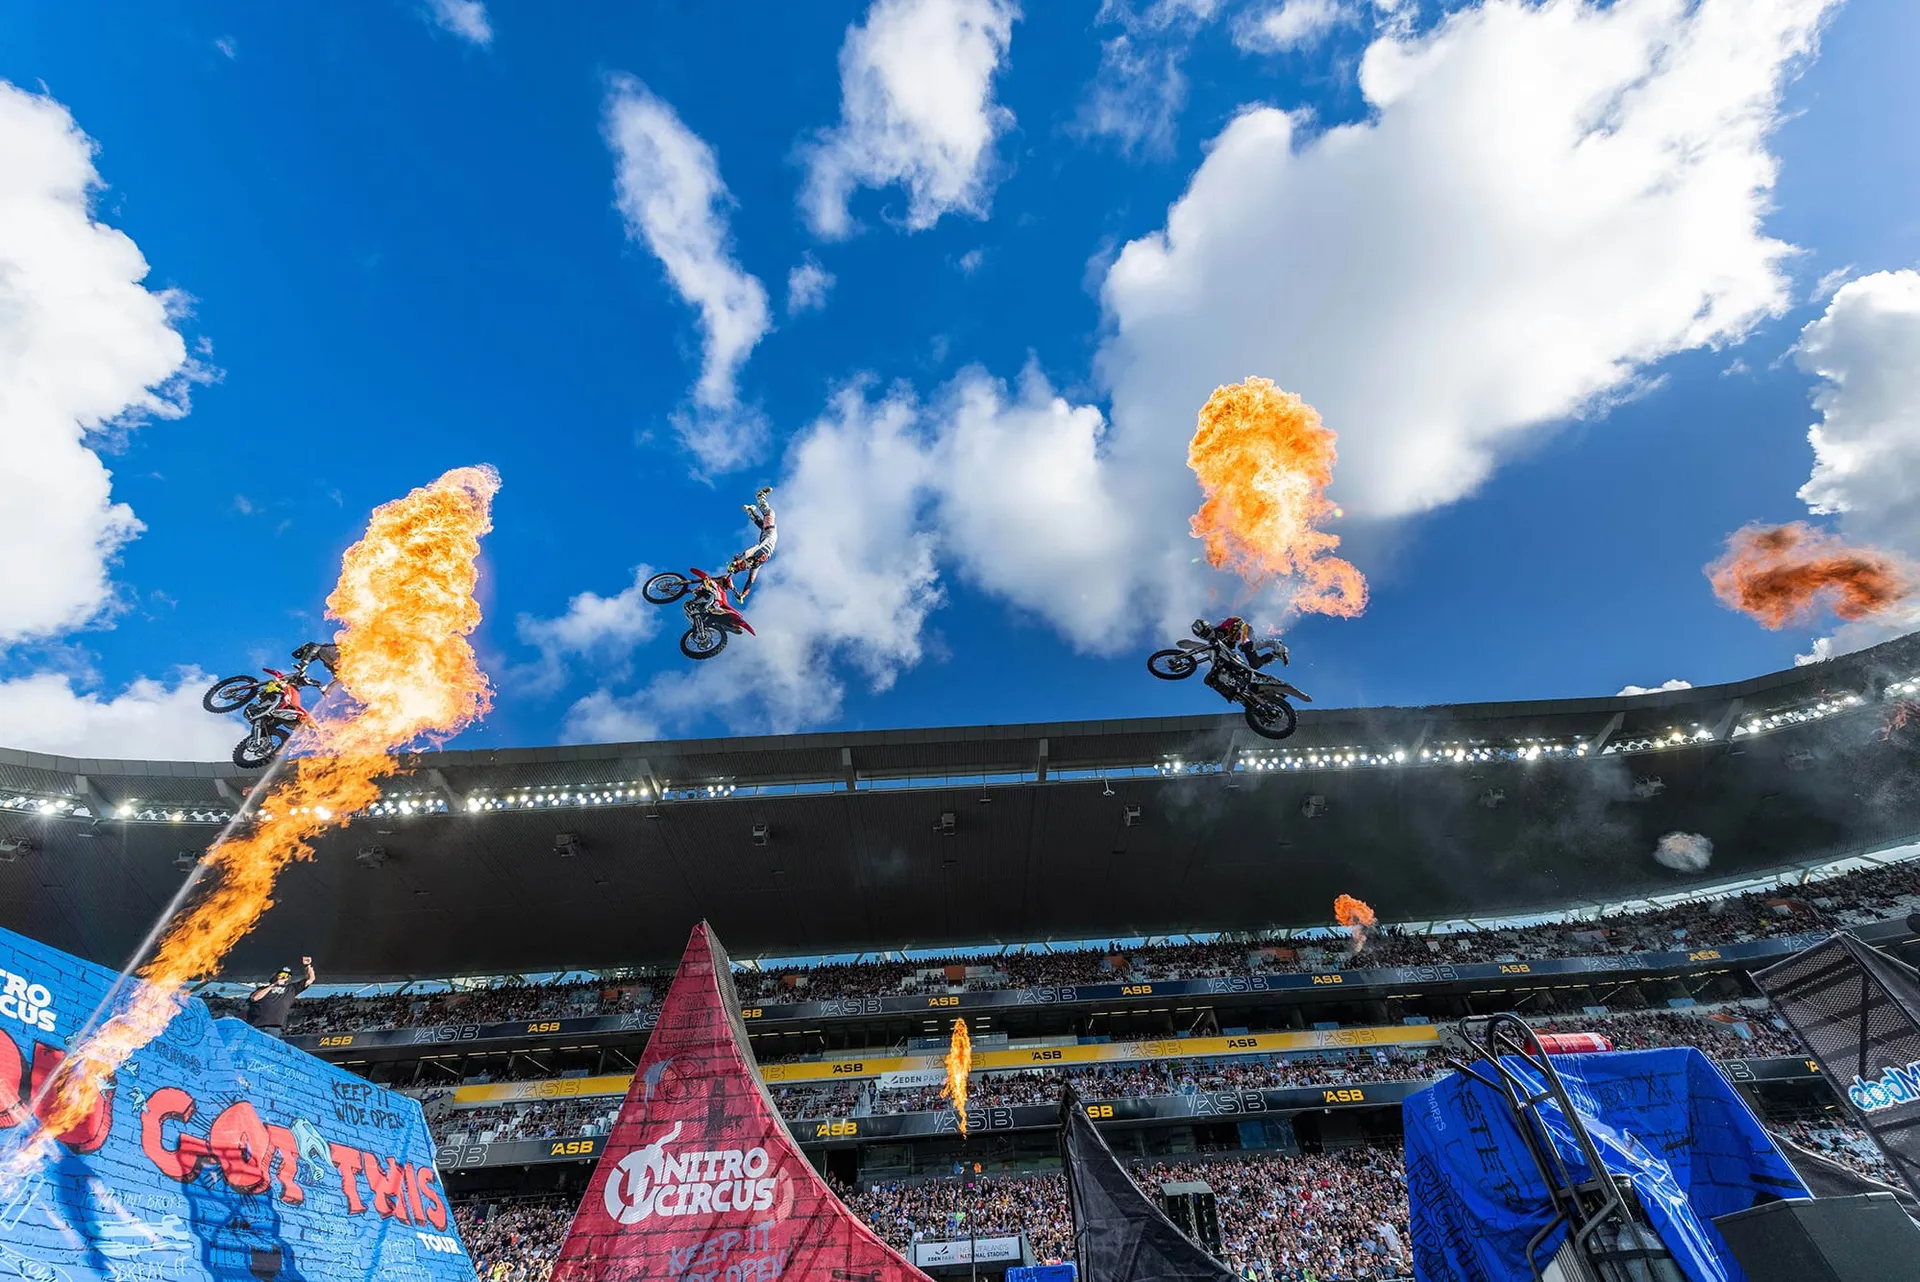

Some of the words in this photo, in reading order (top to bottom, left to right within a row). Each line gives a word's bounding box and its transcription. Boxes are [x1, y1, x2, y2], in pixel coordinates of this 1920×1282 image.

[1397, 965, 1459, 983] ASB
[1499, 963, 1530, 974] ASB
[1207, 975, 1269, 993] ASB
[1312, 974, 1343, 984] ASB
[1016, 986, 1078, 1004] ASB
[1121, 986, 1152, 995] ASB
[821, 997, 882, 1016] ASB
[928, 997, 959, 1007] ASB
[742, 1009, 762, 1018] SB
[413, 1024, 480, 1044] ASB
[528, 1022, 560, 1033] ASB
[319, 1036, 353, 1047] ASB
[1226, 1038, 1257, 1048] ASB
[1315, 1028, 1377, 1046] ASB
[1031, 1050, 1062, 1061] ASB
[1123, 1039, 1183, 1058] ASB
[832, 1063, 863, 1073] ASB
[899, 1075, 922, 1083] EDEN
[330, 1077, 372, 1102] KEEP
[377, 1085, 390, 1108] IT
[516, 1078, 581, 1099] ASB
[1323, 1089, 1364, 1102] ASB
[1087, 1105, 1113, 1119] SB
[1185, 1090, 1267, 1117] ASB
[332, 1100, 366, 1125] WIDE
[370, 1111, 405, 1128] OPEN
[816, 1122, 857, 1136] ASB
[435, 1143, 489, 1168] SB
[551, 1141, 594, 1155] ASB
[142, 1087, 303, 1205] GOT
[332, 1144, 448, 1233] THIS
[662, 1147, 769, 1184] NITRO
[655, 1178, 777, 1217] CIRCUS
[417, 1232, 461, 1255] TOUR
[669, 1231, 740, 1276] KEEP
[749, 1219, 775, 1254] IT
